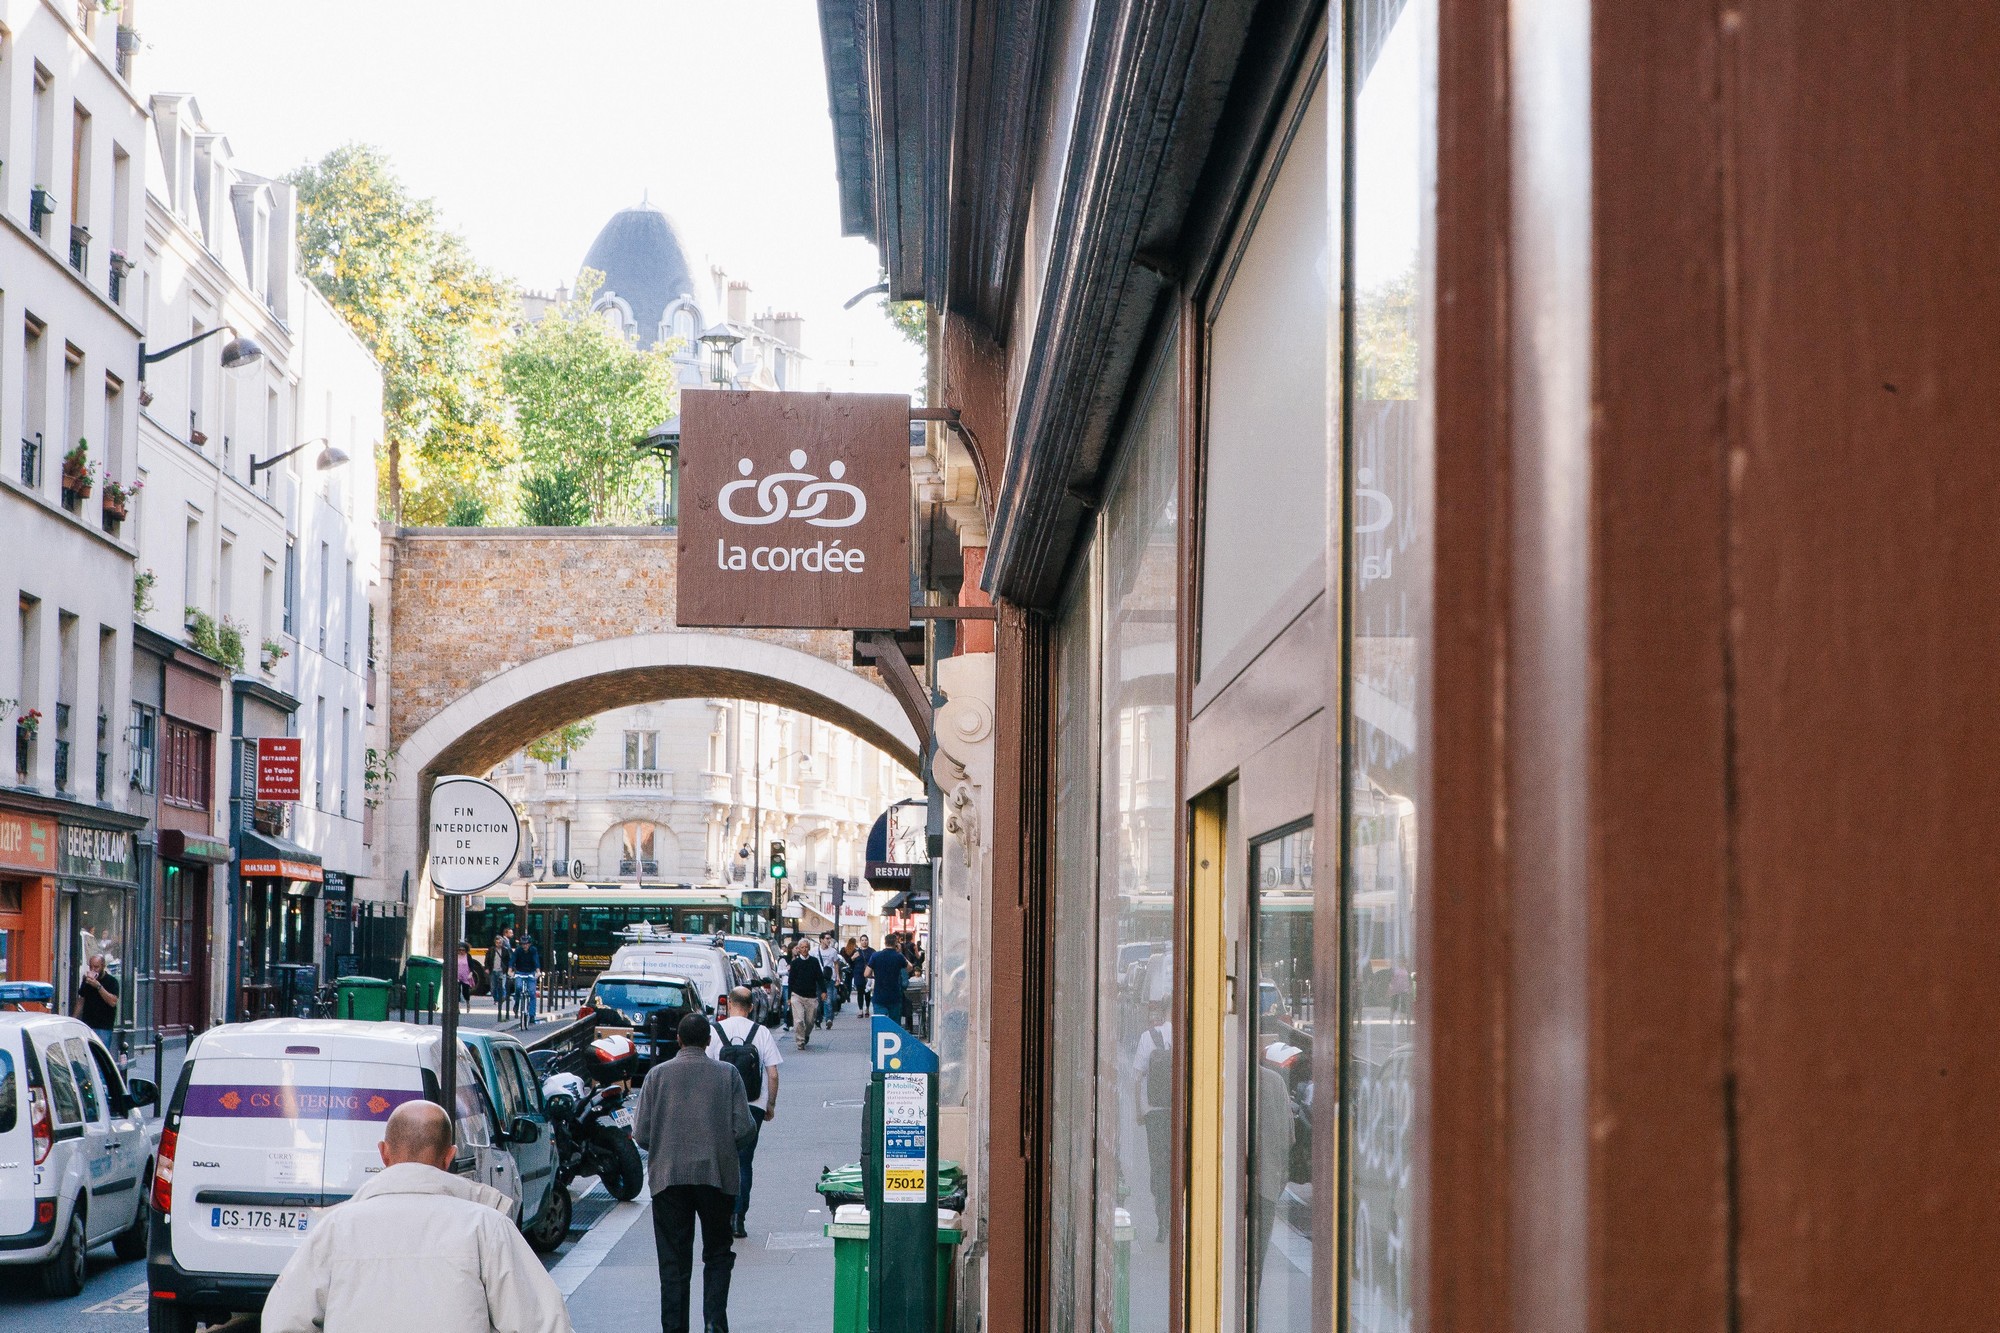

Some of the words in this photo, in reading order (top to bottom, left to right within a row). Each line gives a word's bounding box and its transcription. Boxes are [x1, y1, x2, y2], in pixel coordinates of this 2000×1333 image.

[717, 538, 747, 571] la
[751, 540, 866, 573] cordée
[274, 766, 295, 774] Table
[454, 807, 474, 817] FIN
[68, 827, 94, 860] BEIGE
[100, 831, 127, 864] BLANC
[456, 840, 471, 849] DE
[432, 856, 500, 866] STATIONNER
[875, 867, 911, 877] RESTAU
[250, 1092, 271, 1108] CS
[273, 1093, 360, 1110] CATERING
[192, 1160, 221, 1168] DACIA
[886, 1177, 925, 1189] 75012
